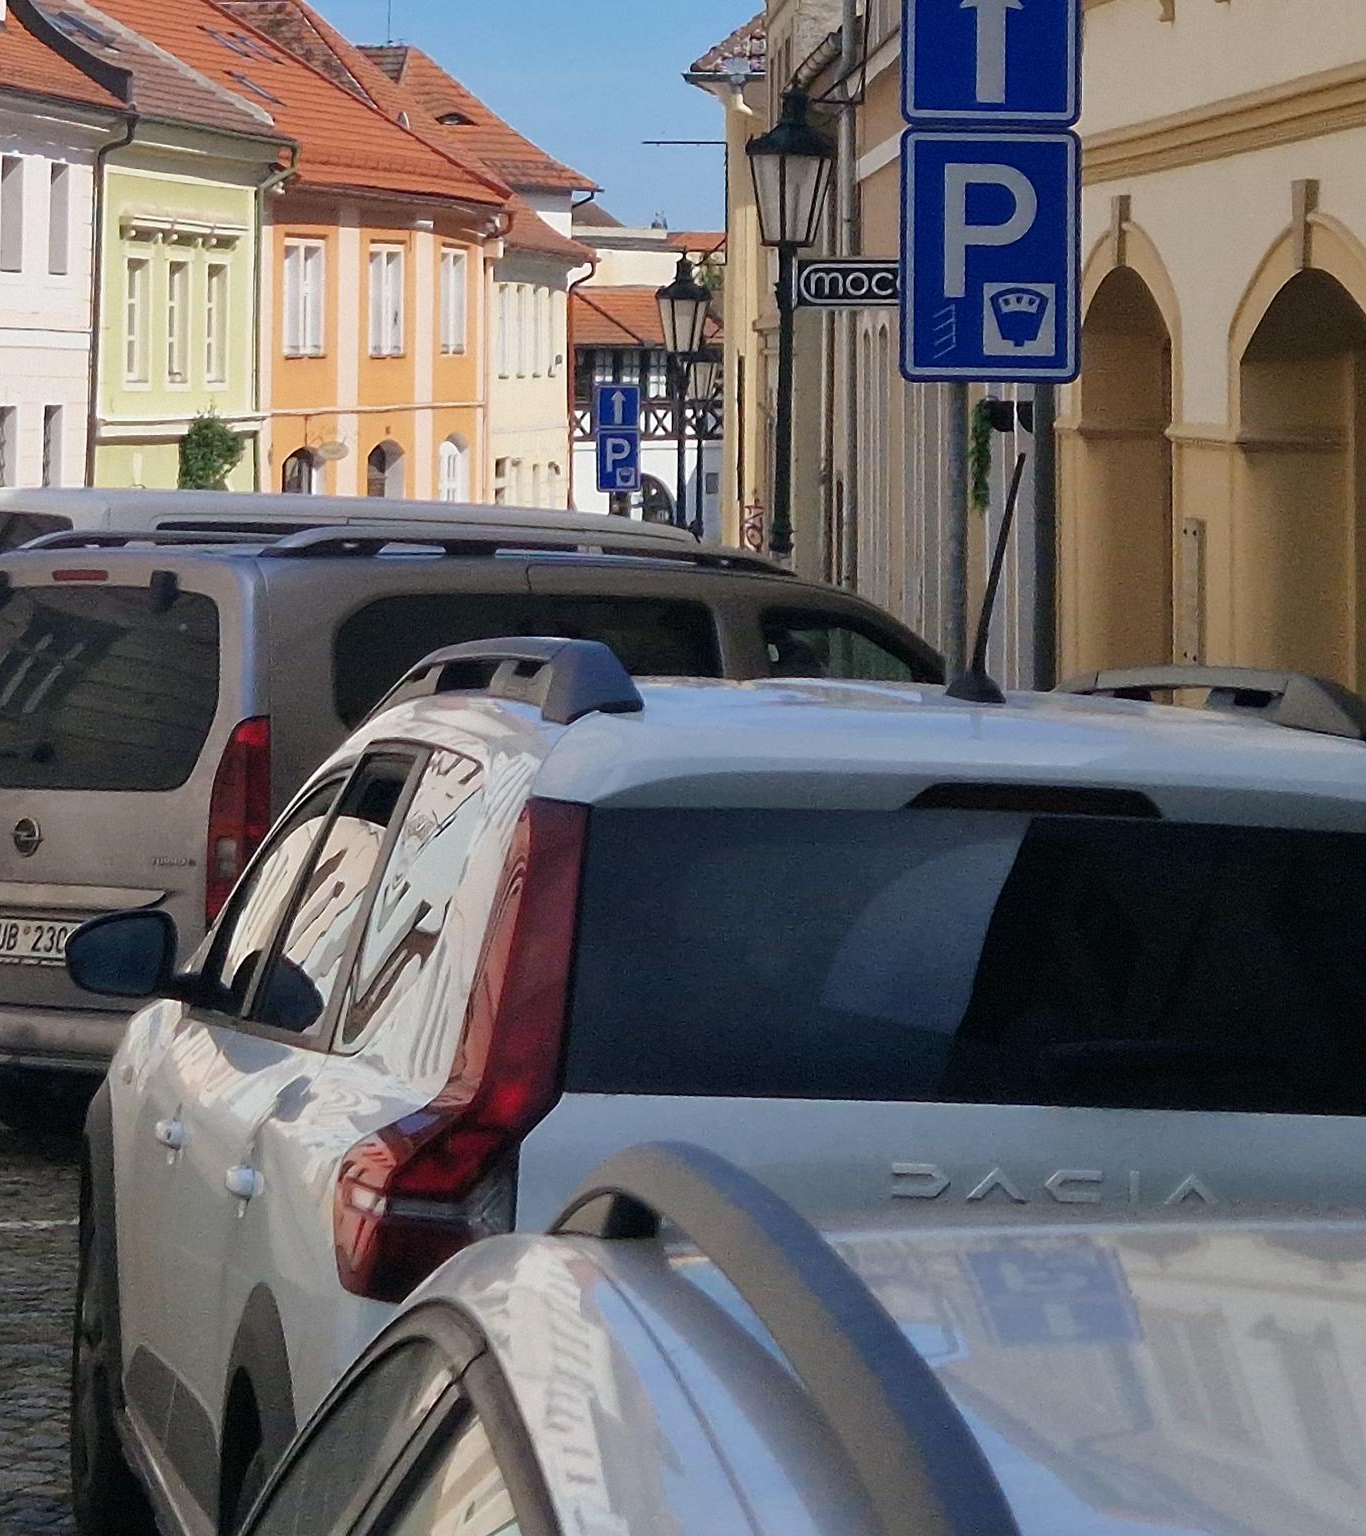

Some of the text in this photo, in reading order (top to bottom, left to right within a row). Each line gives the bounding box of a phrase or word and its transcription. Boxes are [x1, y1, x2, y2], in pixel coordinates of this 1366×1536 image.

[943, 163, 1037, 299] P
[810, 271, 901, 296] moc
[606, 437, 632, 473] P
[891, 1162, 1220, 1206] DACIA
